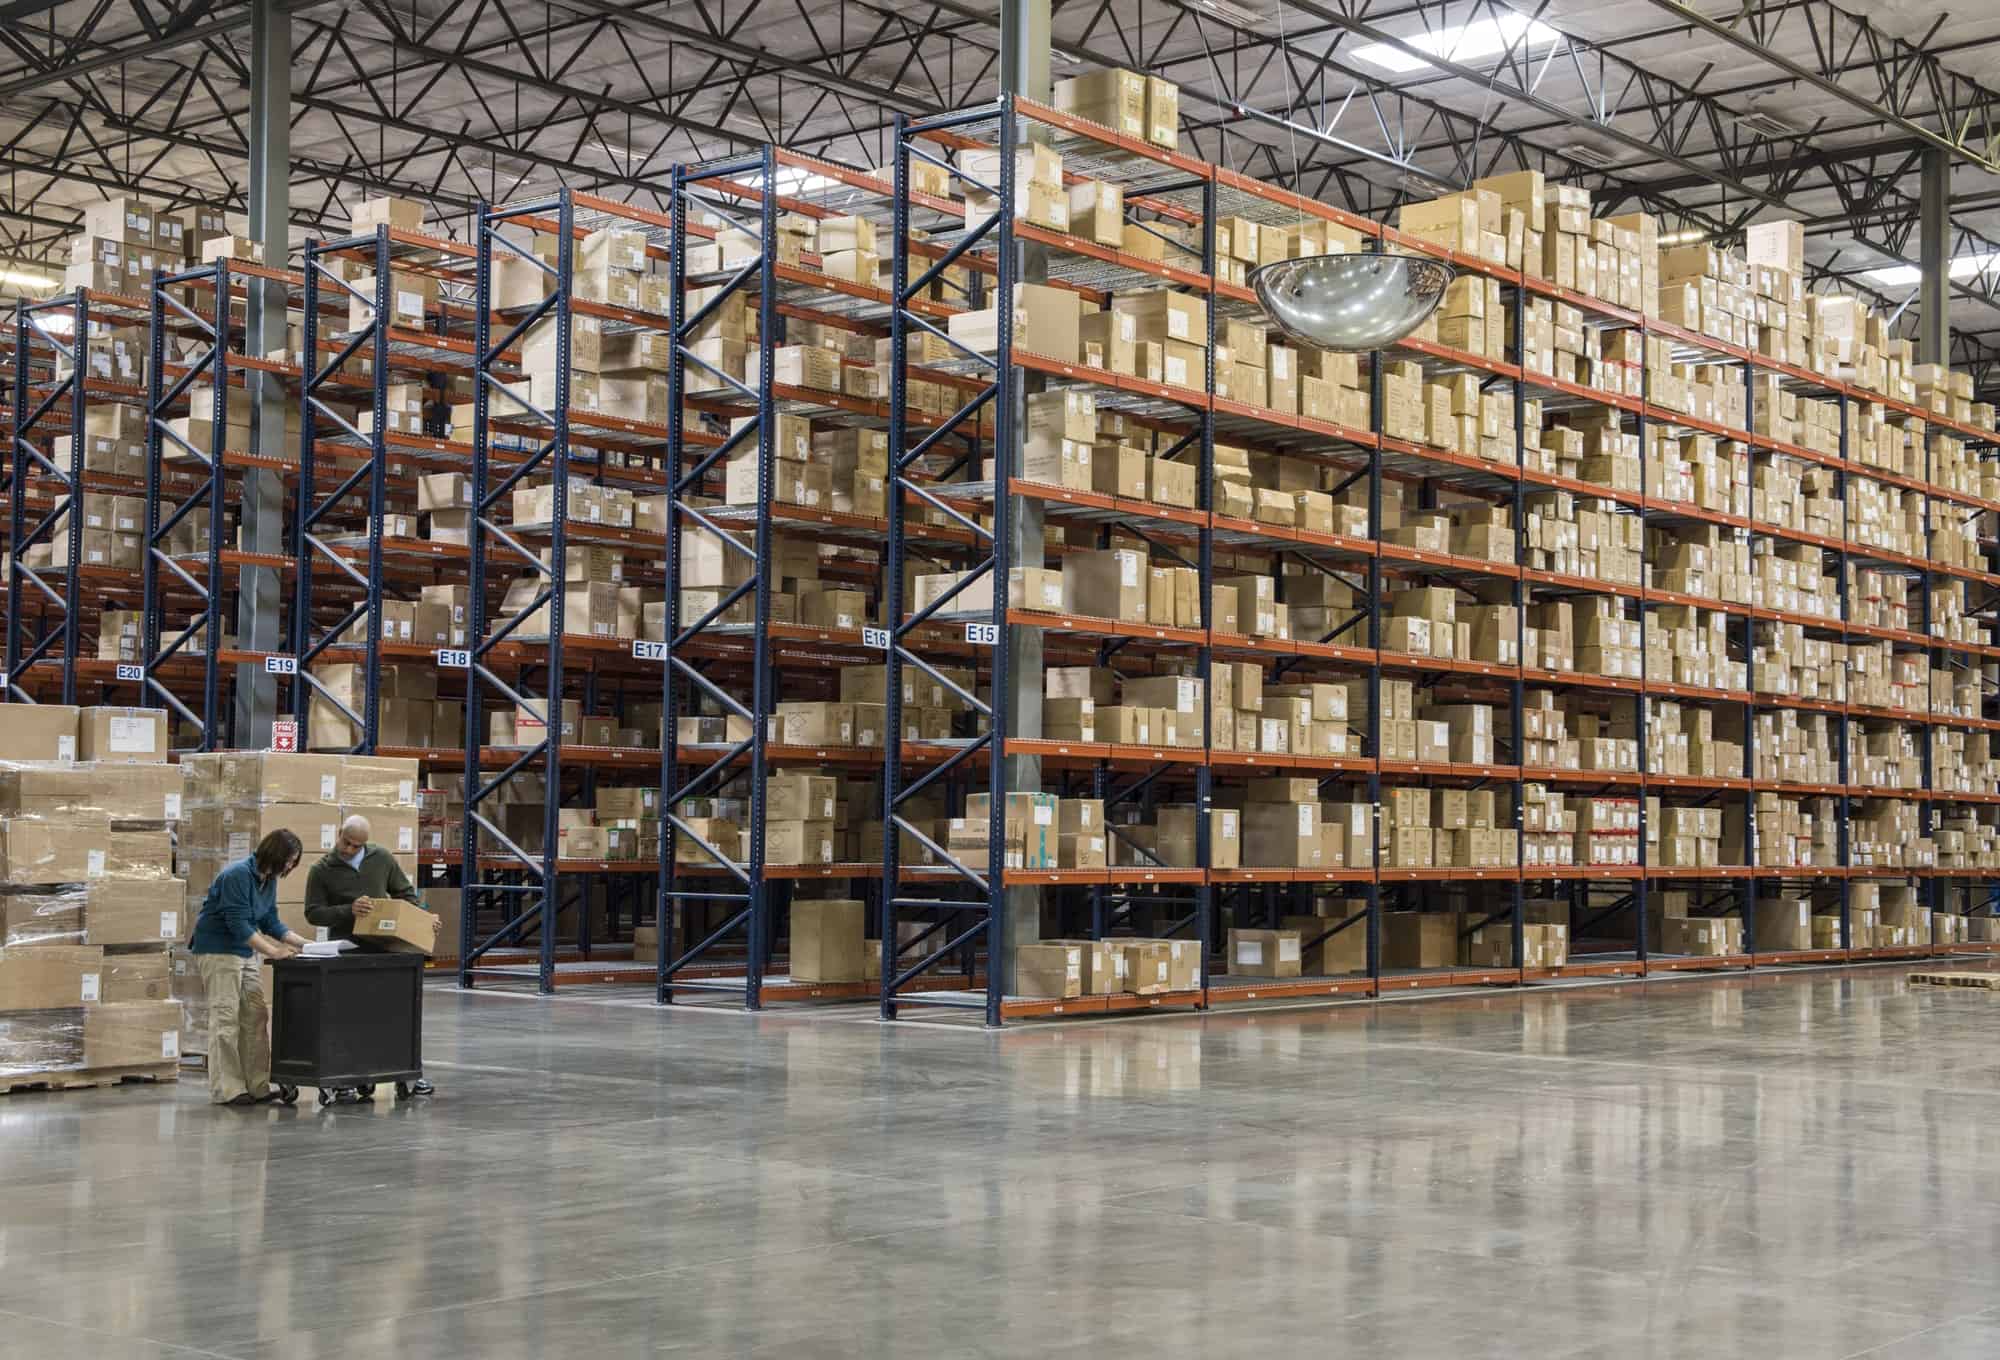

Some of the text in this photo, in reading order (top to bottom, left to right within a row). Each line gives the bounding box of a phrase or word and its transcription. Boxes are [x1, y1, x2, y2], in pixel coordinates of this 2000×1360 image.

[865, 630, 886, 647] E16
[968, 625, 993, 641] E15
[635, 642, 663, 657] E17
[440, 651, 466, 664] E18
[268, 659, 293, 671] E19
[119, 666, 140, 679] E20
